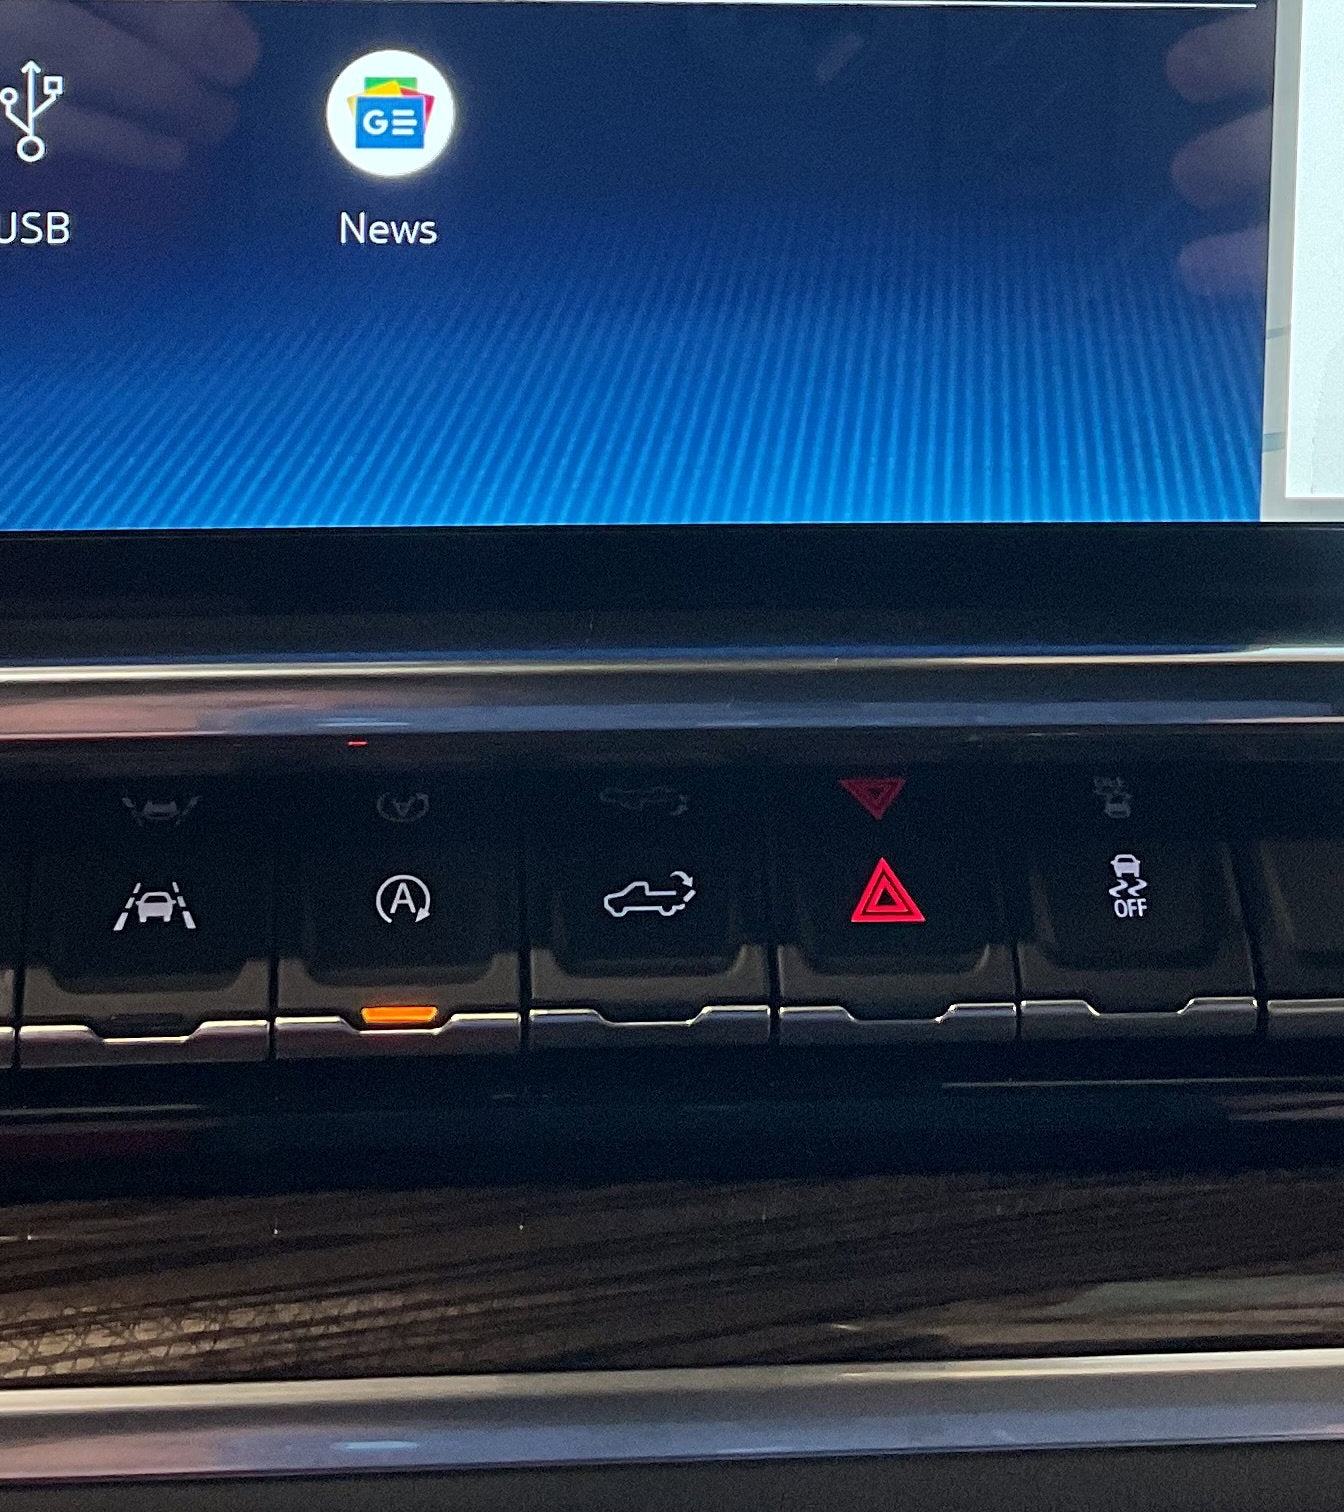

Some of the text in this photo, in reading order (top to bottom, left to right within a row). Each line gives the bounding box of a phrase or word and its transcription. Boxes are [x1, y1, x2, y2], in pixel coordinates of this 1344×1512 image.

[341, 211, 437, 245] News
[389, 882, 416, 914] A
[1114, 898, 1147, 918] OFF
